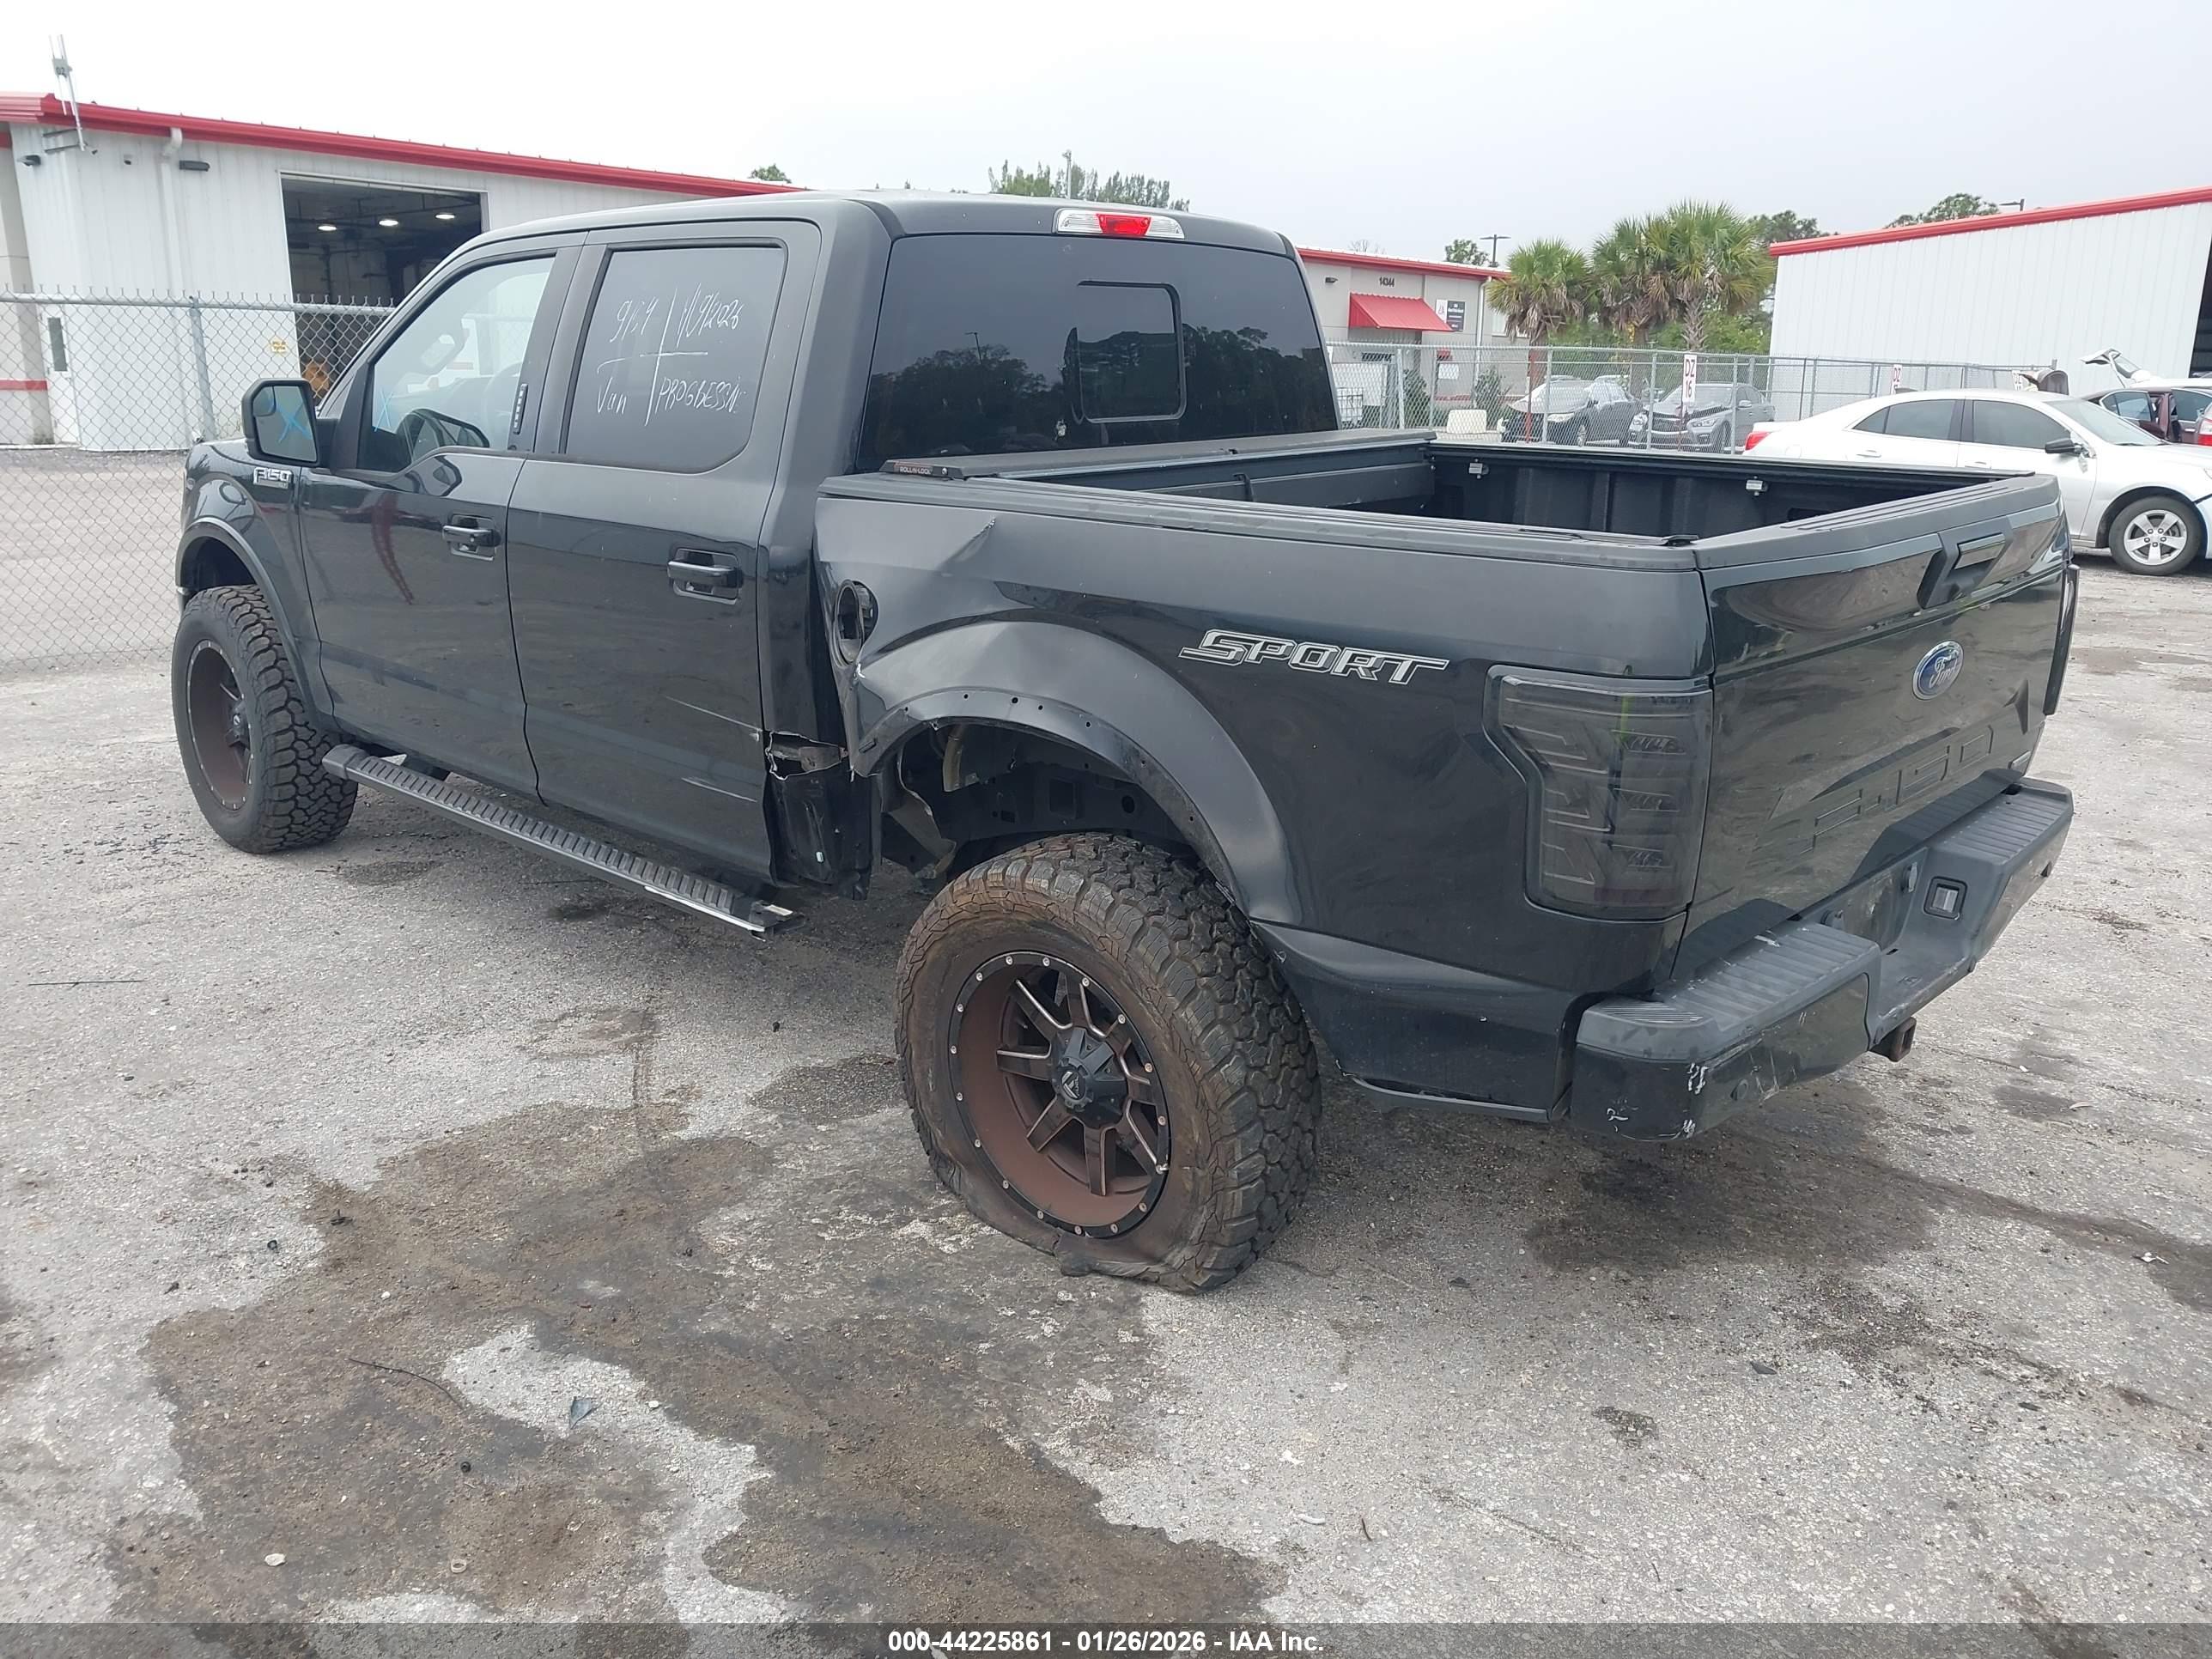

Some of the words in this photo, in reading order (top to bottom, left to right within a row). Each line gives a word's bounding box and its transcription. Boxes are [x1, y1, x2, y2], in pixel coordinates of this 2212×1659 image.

[1685, 359, 1696, 378] DZ
[1686, 380, 1692, 398] 16
[1178, 629, 1449, 685] SPORT
